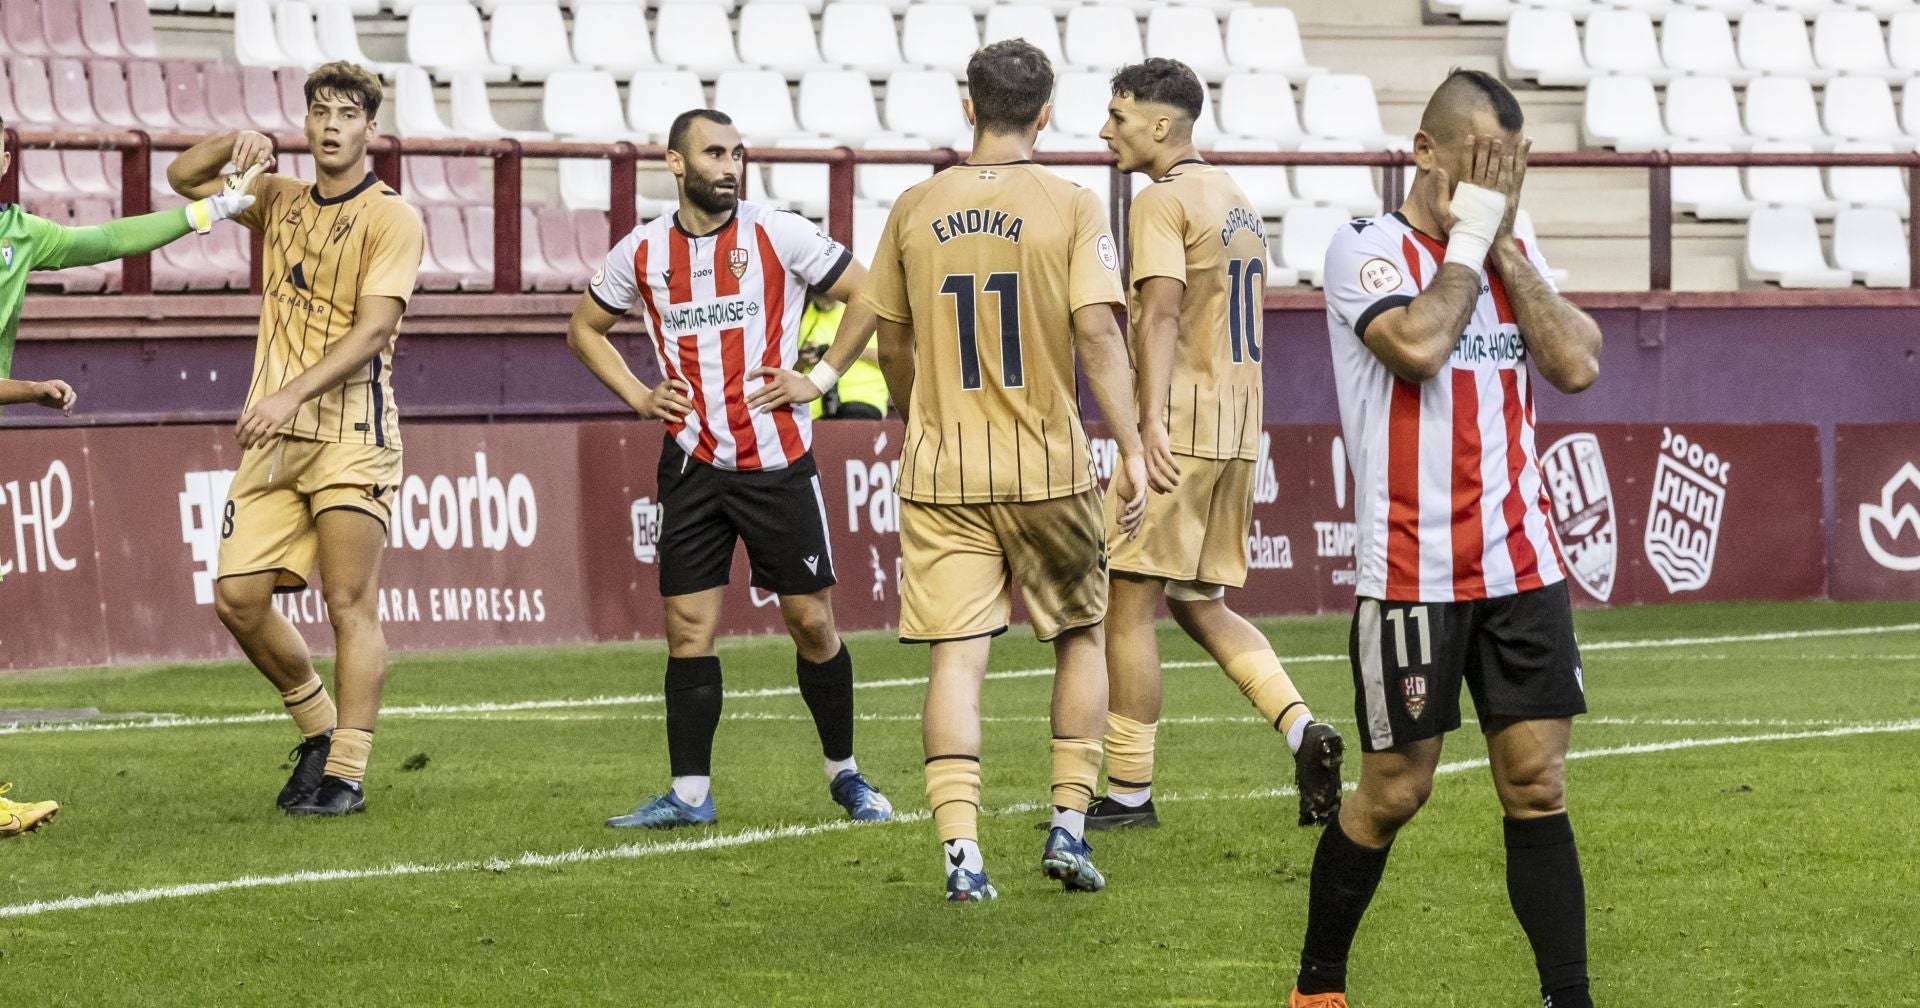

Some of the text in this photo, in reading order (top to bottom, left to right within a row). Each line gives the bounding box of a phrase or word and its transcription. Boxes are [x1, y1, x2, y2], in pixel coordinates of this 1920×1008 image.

[930, 207, 1024, 246] ENDIKA
[692, 268, 713, 279] 2009
[671, 301, 744, 331] NATUR HOUSE
[1227, 257, 1264, 364] 10
[938, 271, 1025, 391] 11
[221, 499, 235, 539] 8
[1313, 521, 1357, 557] TEMP
[378, 588, 420, 622] ARA
[429, 587, 546, 622] EMPRESAS
[1386, 605, 1431, 668] 11
